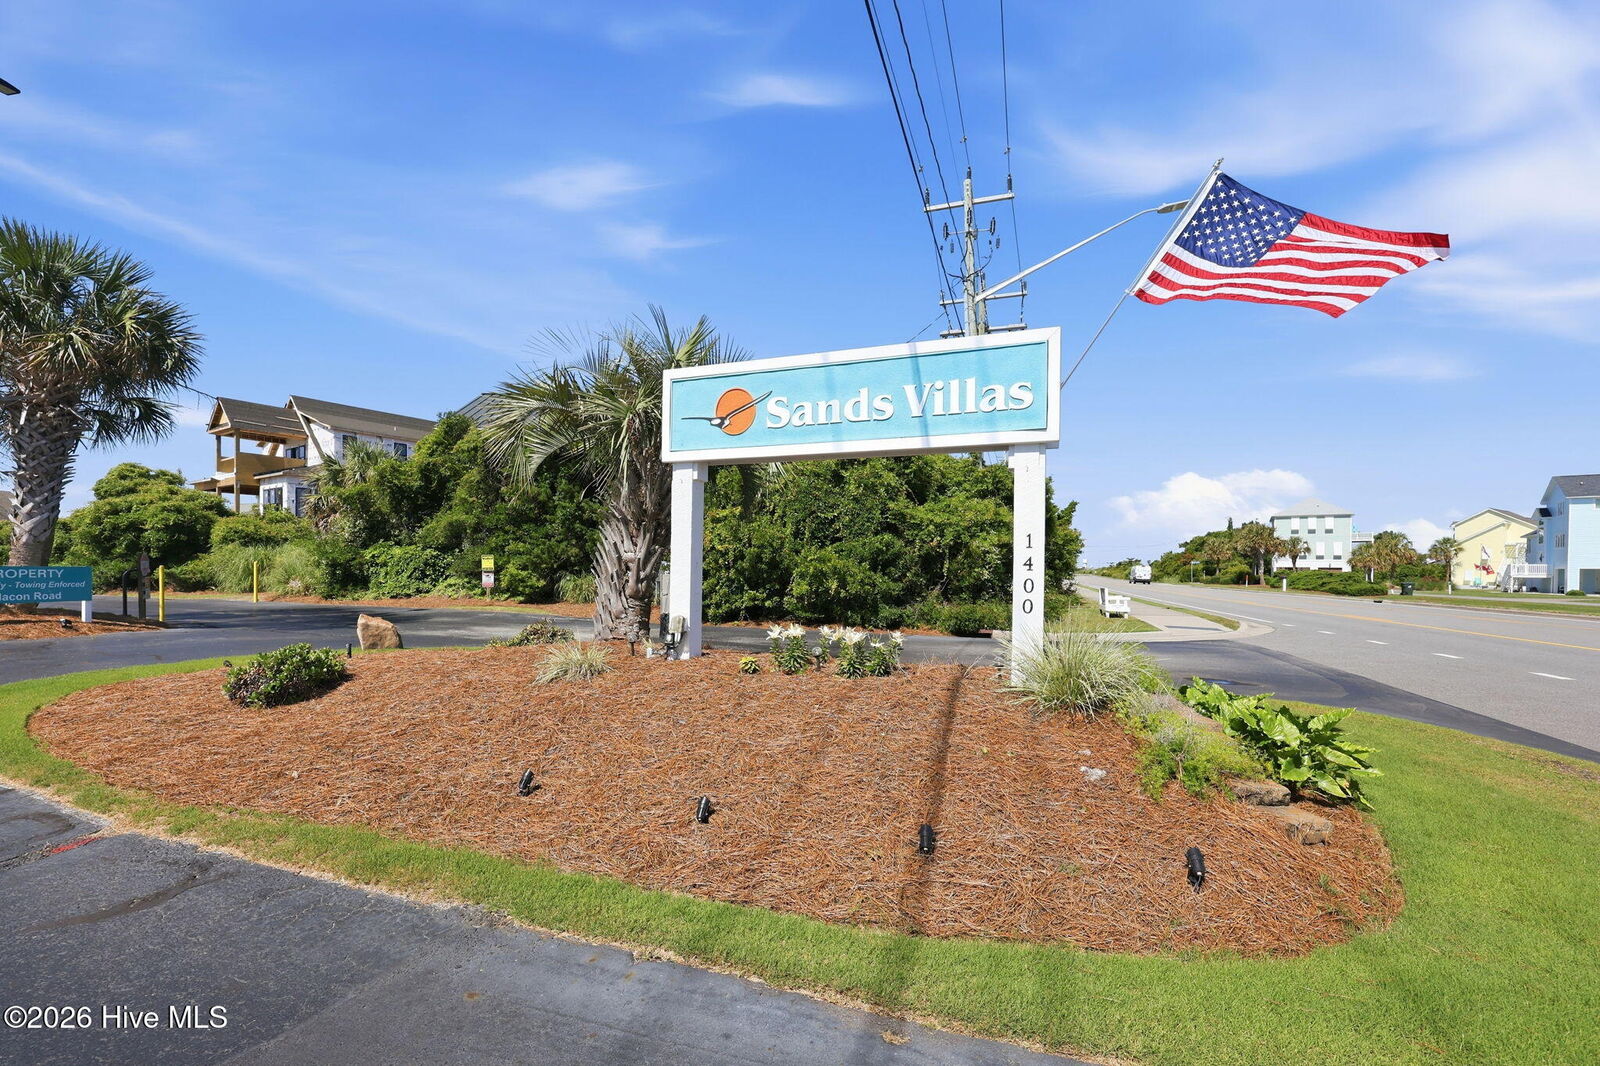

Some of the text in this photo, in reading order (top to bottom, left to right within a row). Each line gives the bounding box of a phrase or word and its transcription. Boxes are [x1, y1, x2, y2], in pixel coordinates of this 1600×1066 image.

[766, 377, 1034, 428] Sands Villas
[15, 581, 46, 589] Towing
[48, 580, 85, 588] Enforced
[1022, 533, 1035, 614] 1400
[0, 592, 61, 601] acon Road
